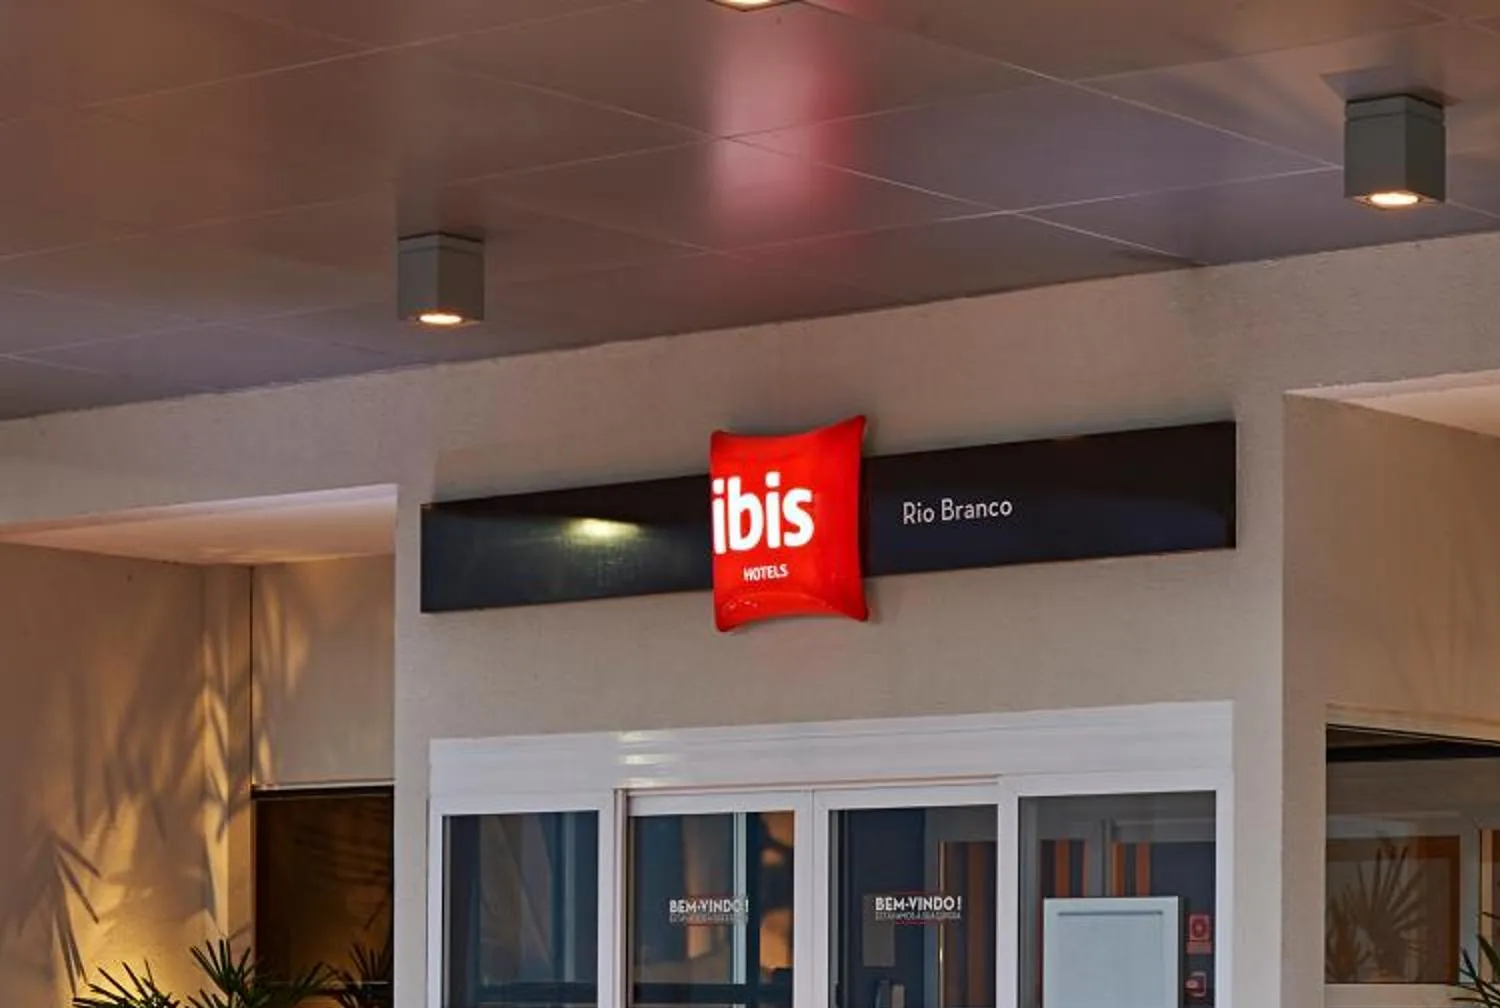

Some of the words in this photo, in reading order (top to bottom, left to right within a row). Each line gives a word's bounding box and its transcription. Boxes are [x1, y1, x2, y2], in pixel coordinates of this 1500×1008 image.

[711, 471, 815, 555] ibis
[902, 501, 935, 525] Rio
[941, 498, 1013, 522] Branco
[743, 563, 789, 582] HOTELS
